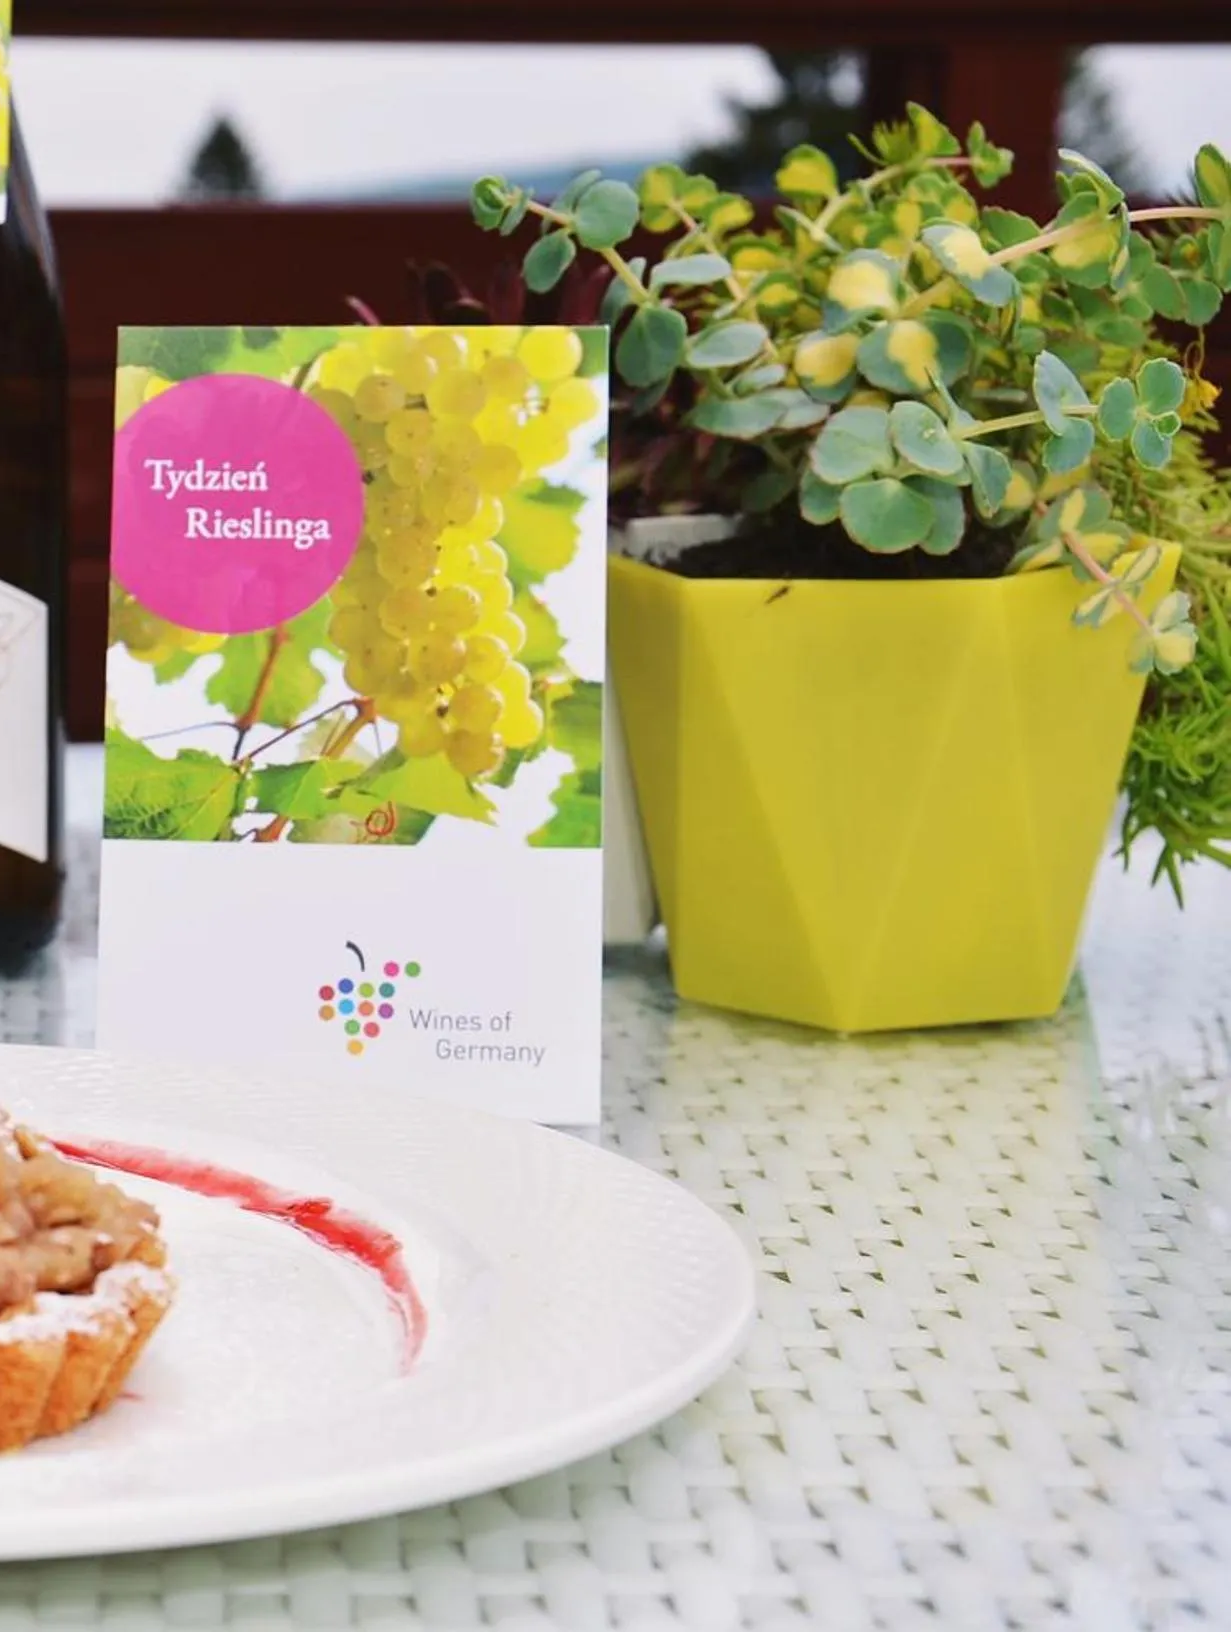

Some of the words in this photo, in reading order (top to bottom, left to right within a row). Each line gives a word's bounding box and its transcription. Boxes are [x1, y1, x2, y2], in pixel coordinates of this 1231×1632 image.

[143, 458, 269, 500] Tydzień
[184, 507, 332, 550] Rieslinga
[409, 1008, 482, 1032] Wines
[489, 1010, 513, 1032] of
[435, 1037, 546, 1067] Germany
